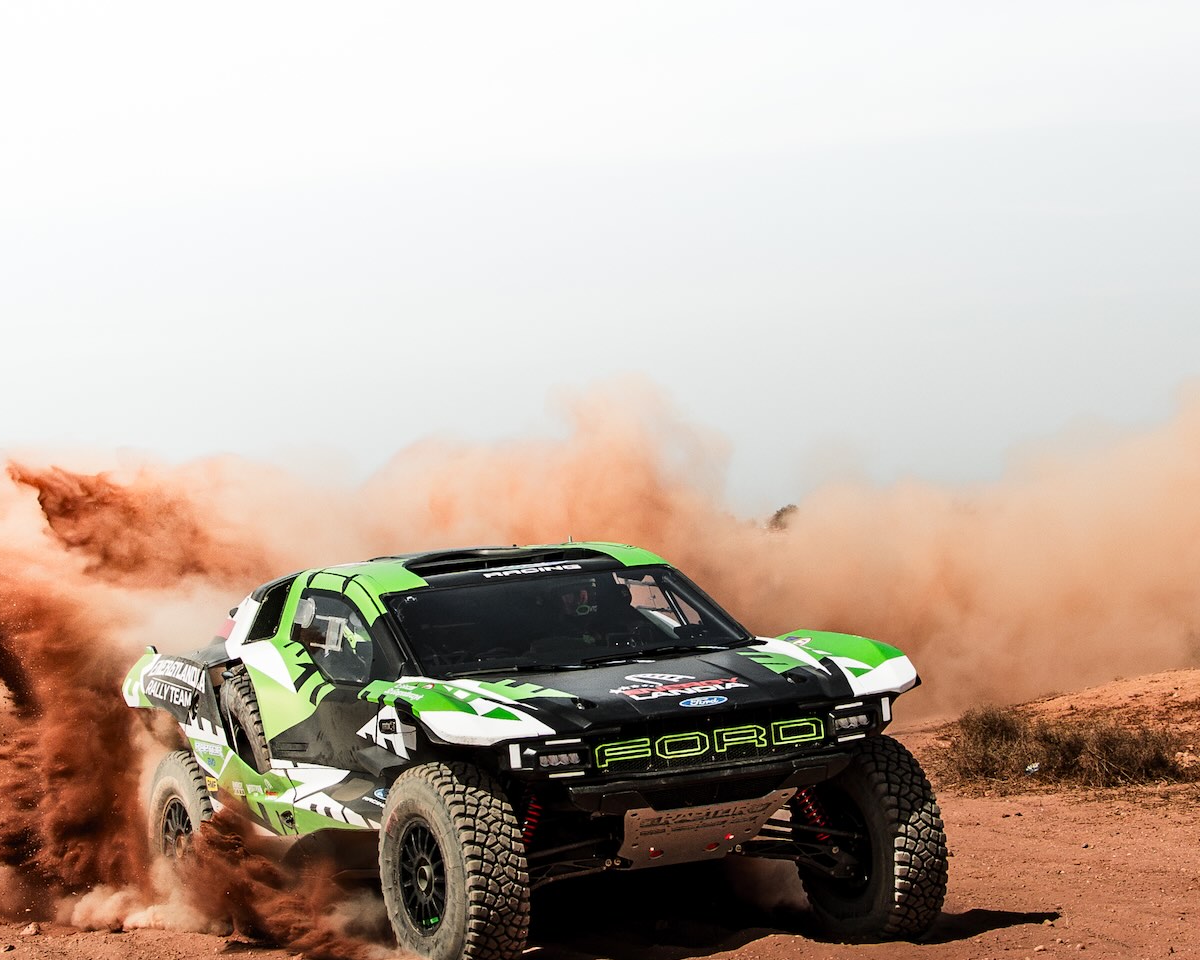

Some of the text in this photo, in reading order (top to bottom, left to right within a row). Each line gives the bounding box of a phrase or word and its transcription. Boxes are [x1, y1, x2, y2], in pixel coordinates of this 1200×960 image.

[145, 680, 192, 708] RALLY TEAM
[629, 682, 749, 701] LANDIA
[595, 717, 825, 769] FORD
